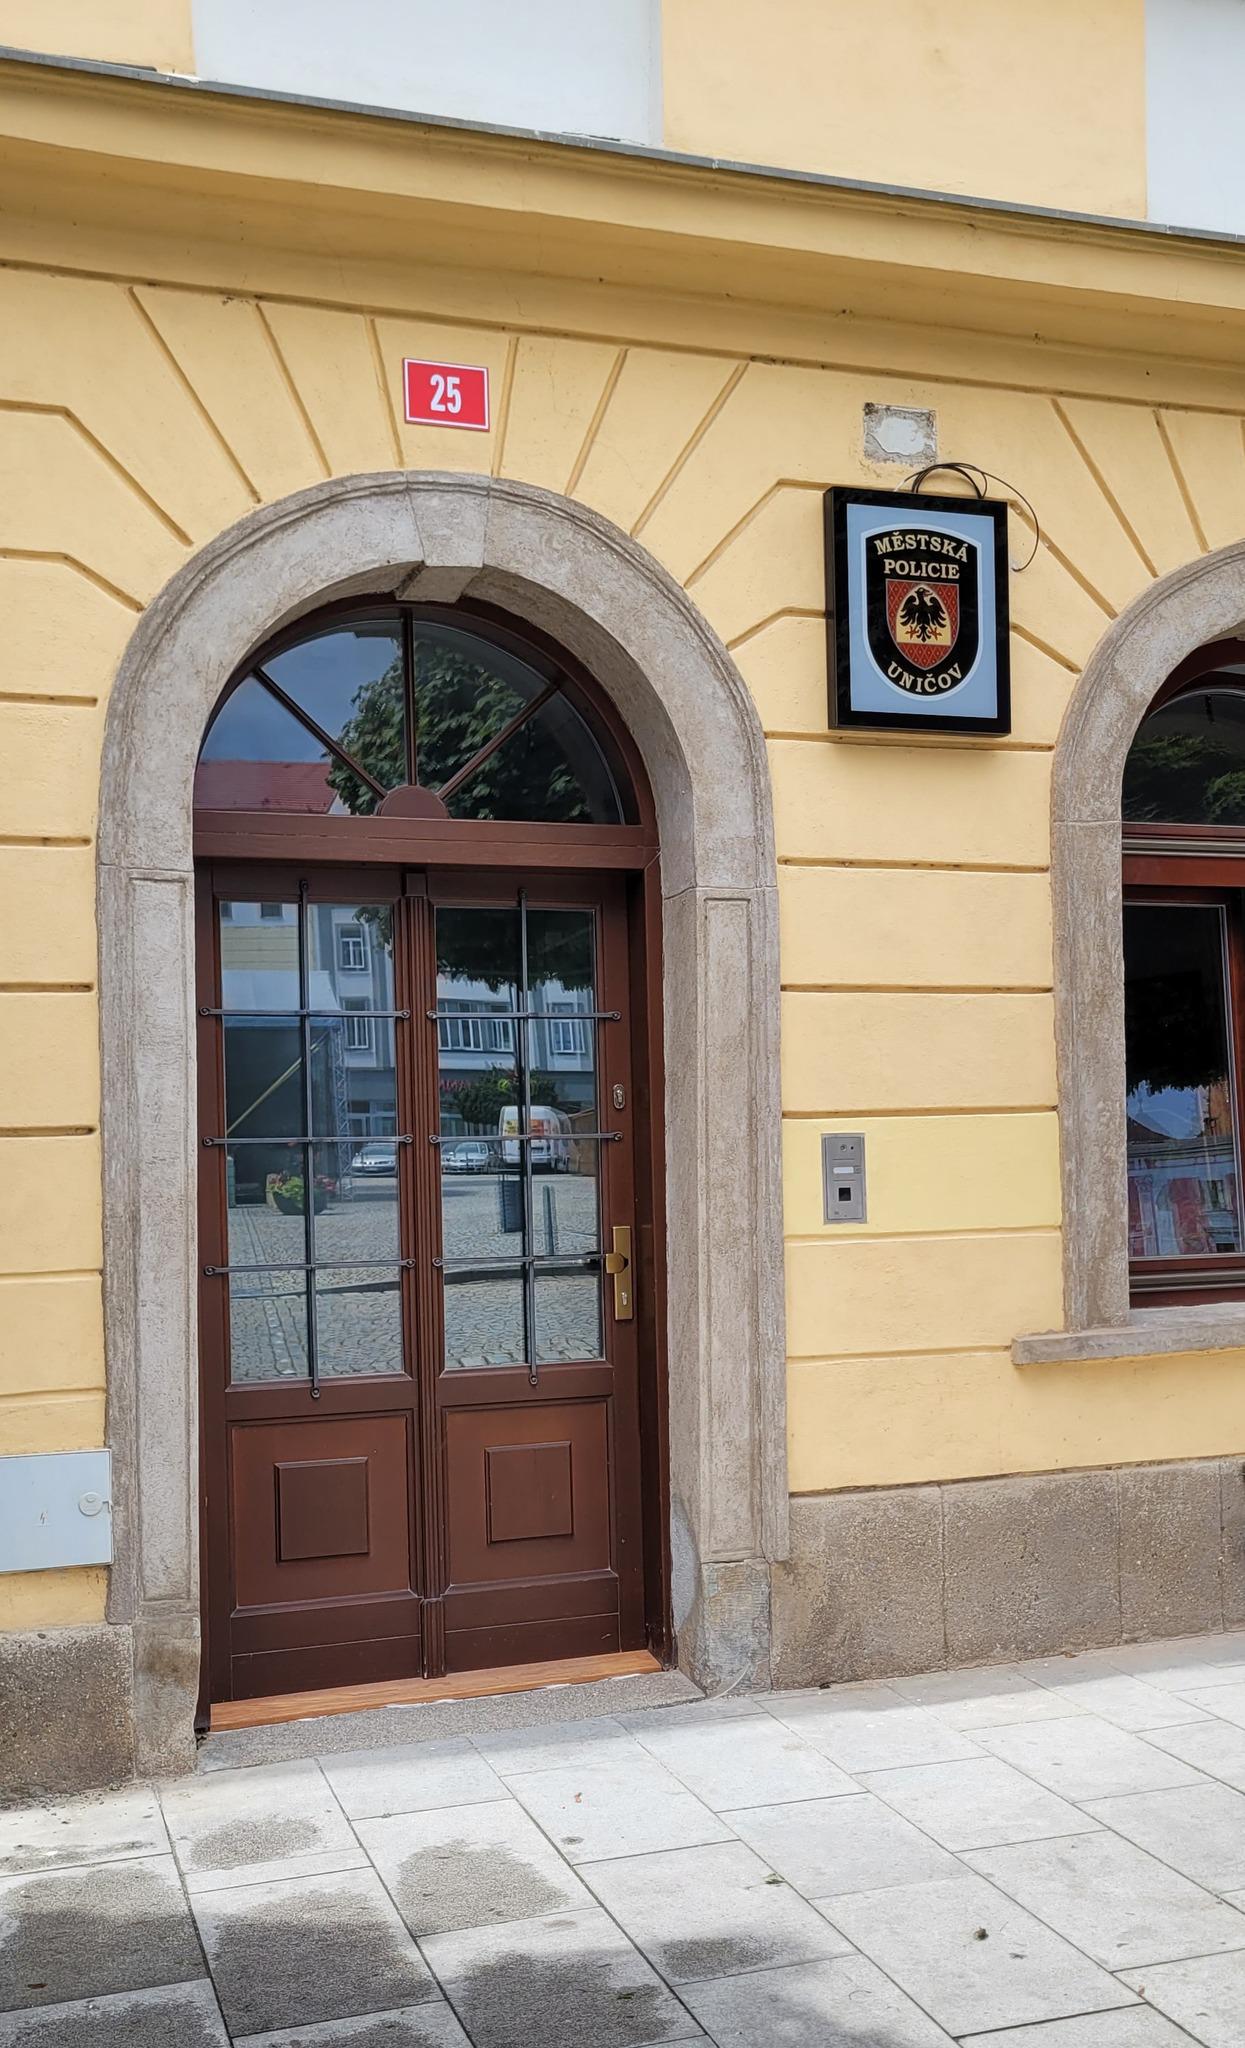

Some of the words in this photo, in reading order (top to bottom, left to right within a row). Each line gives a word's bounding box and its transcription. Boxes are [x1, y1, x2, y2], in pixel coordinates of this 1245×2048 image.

[430, 374, 461, 414] 25
[874, 531, 969, 562] MĚSTSKÁ
[884, 559, 960, 580] POLICIE
[887, 661, 963, 694] UNIČOV
